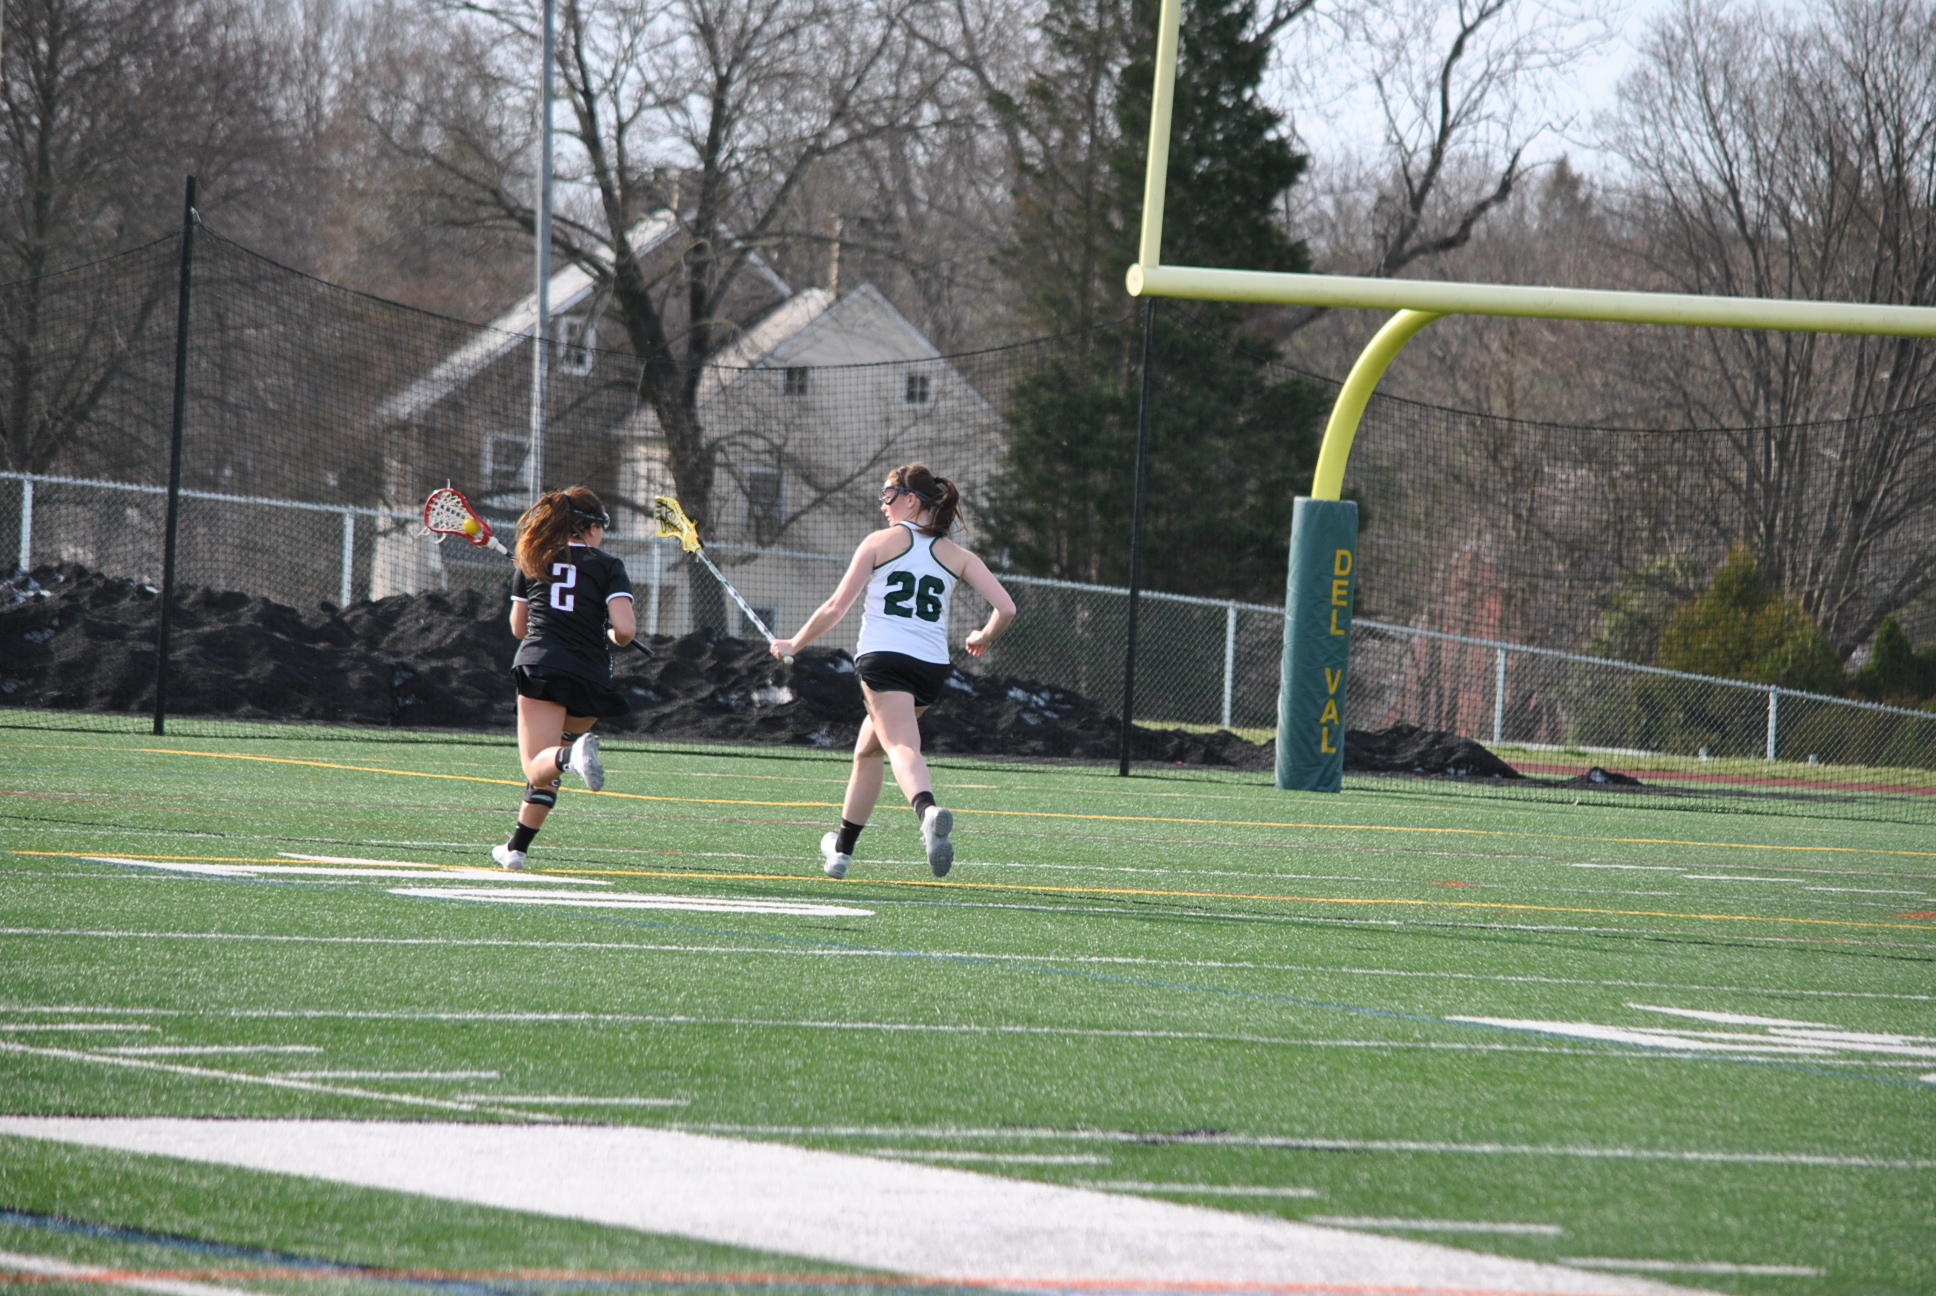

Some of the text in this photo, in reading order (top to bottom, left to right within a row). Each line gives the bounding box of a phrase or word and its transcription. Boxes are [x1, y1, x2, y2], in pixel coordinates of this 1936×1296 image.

[549, 562, 577, 612] 2
[883, 571, 946, 623] 26
[1319, 549, 1353, 753] DEL VAL
